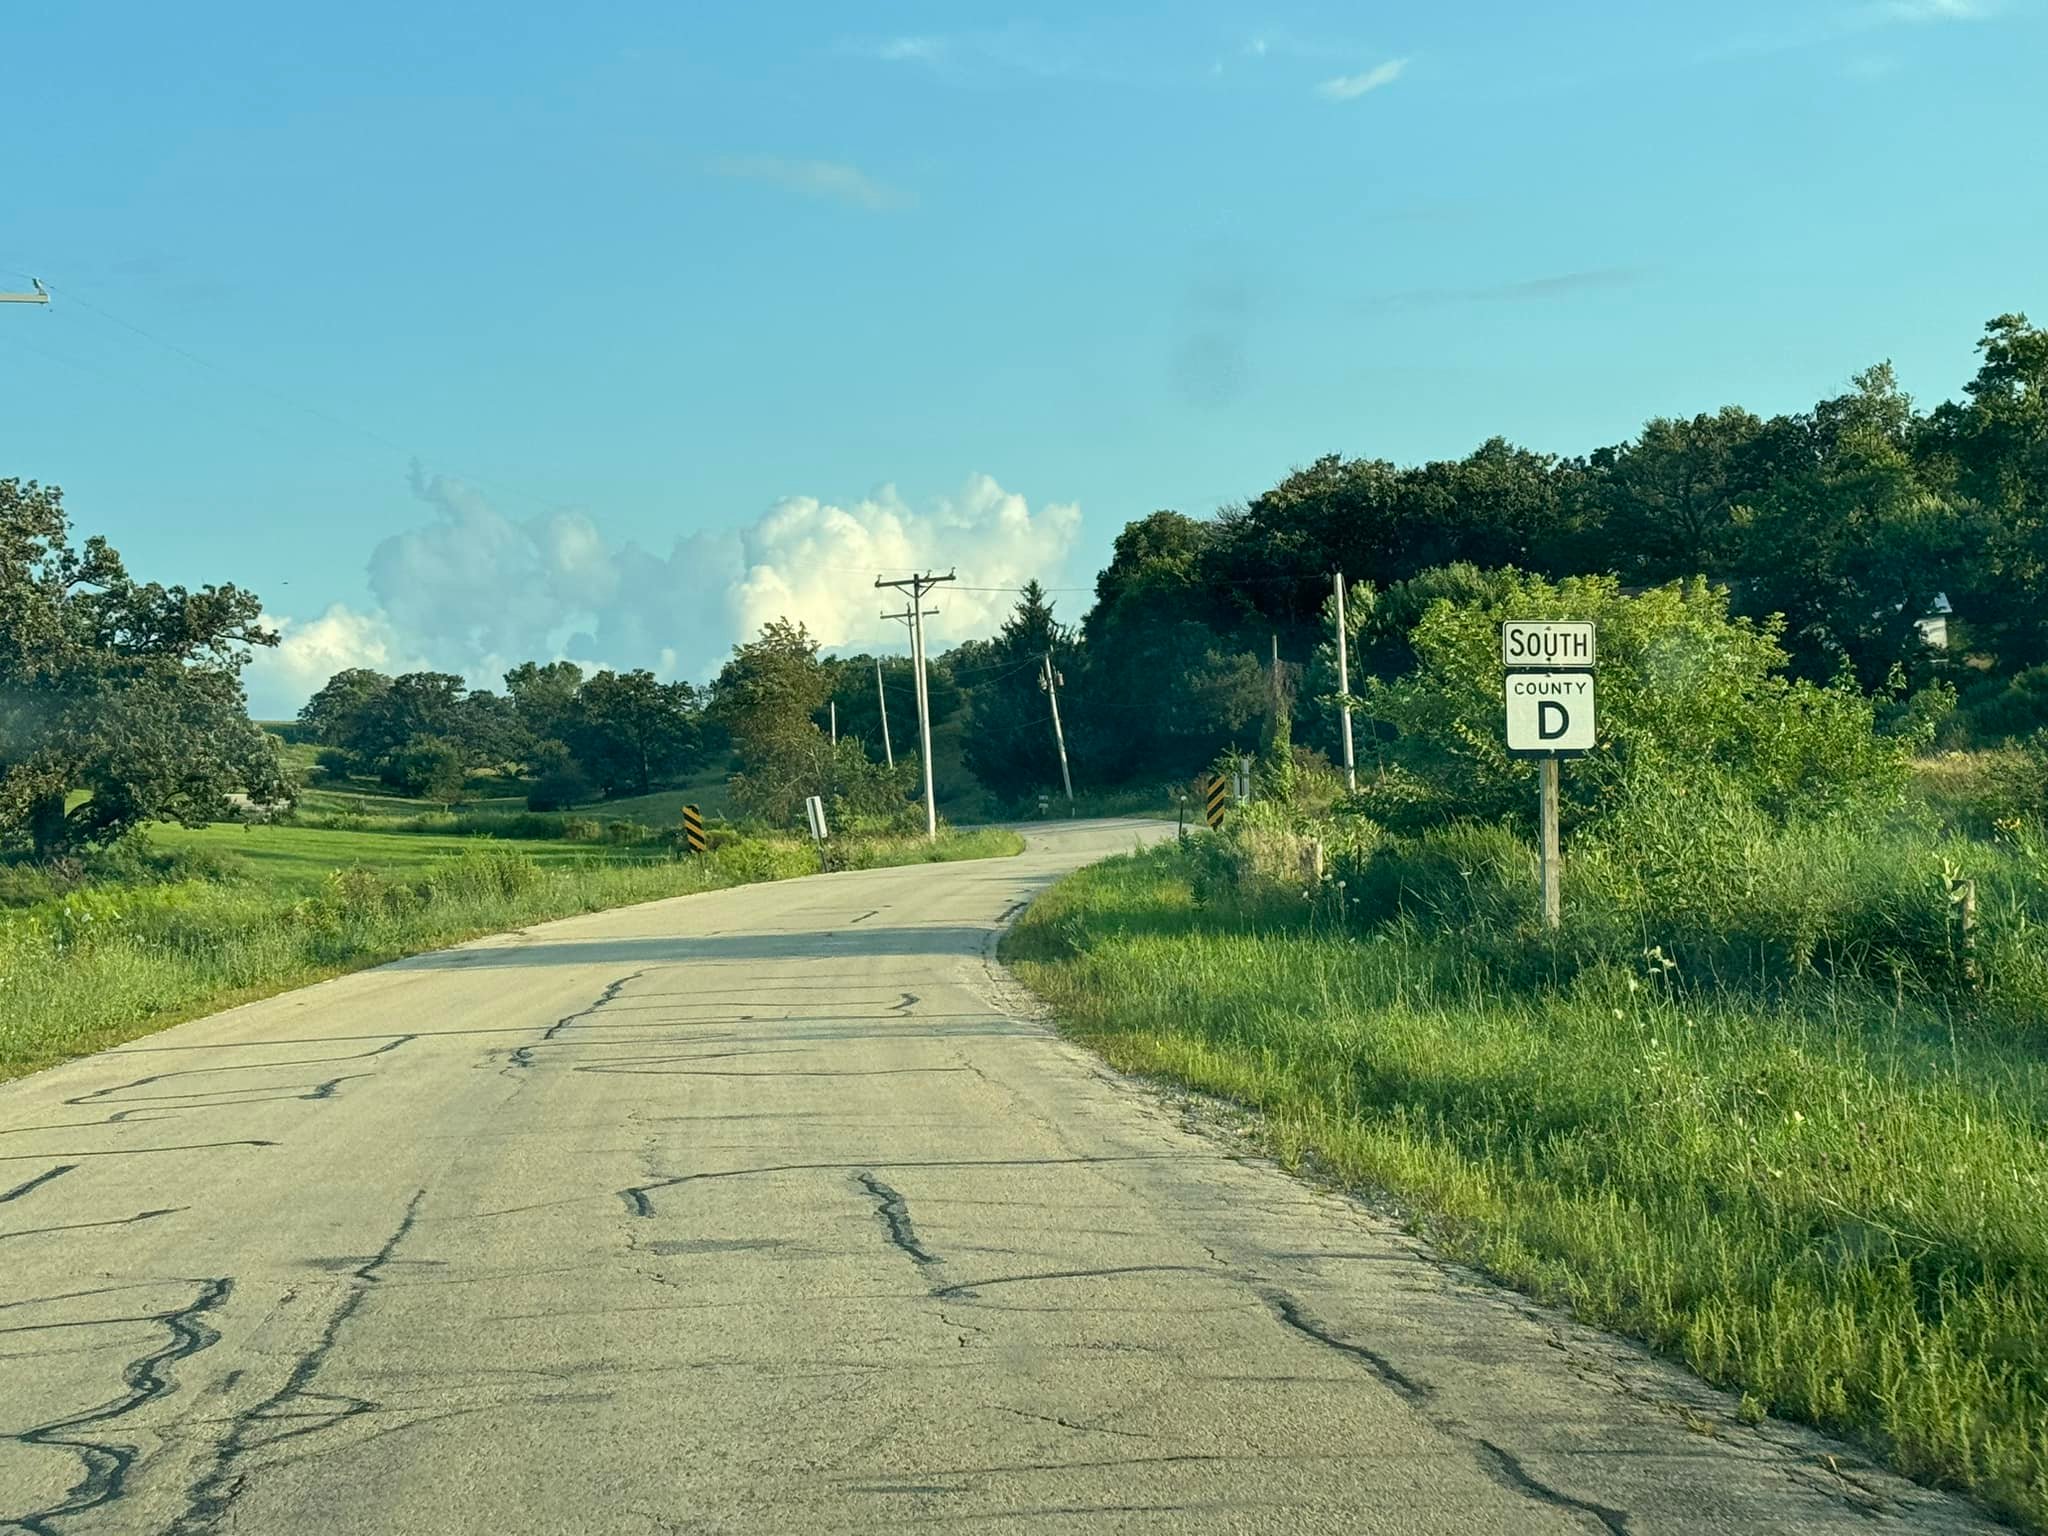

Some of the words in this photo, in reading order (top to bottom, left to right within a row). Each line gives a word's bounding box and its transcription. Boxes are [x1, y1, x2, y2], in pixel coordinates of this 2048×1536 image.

[1510, 629, 1587, 657] SOUTH
[1514, 682, 1586, 695] COUNTY
[1538, 701, 1569, 740] D
